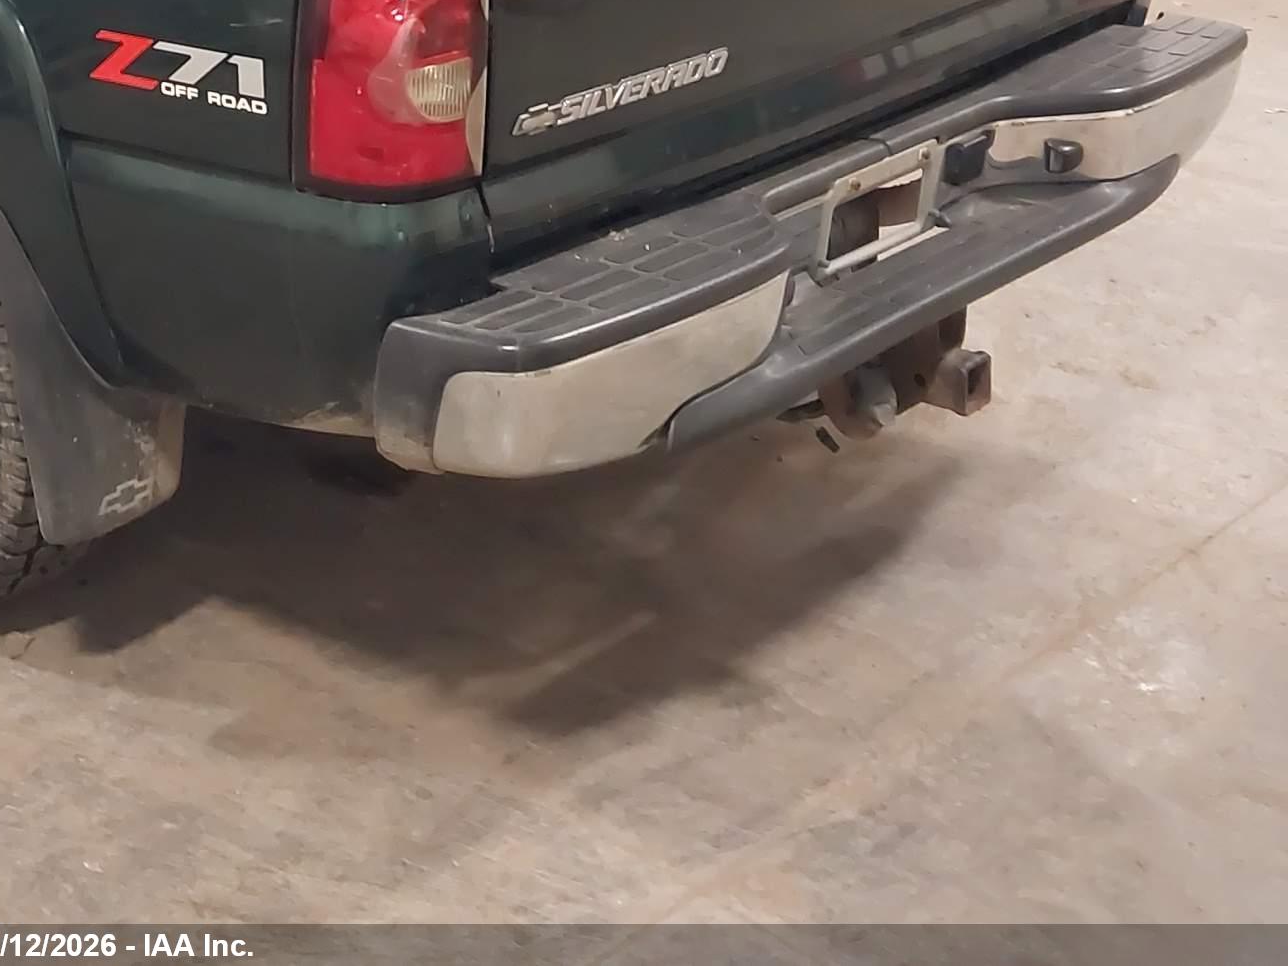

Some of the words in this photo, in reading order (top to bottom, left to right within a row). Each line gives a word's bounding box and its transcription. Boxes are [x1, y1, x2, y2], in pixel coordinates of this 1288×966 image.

[89, 29, 265, 99] Z71
[161, 81, 199, 100] OFF
[207, 91, 268, 115] ROAD
[557, 46, 729, 125] SILVERADO
